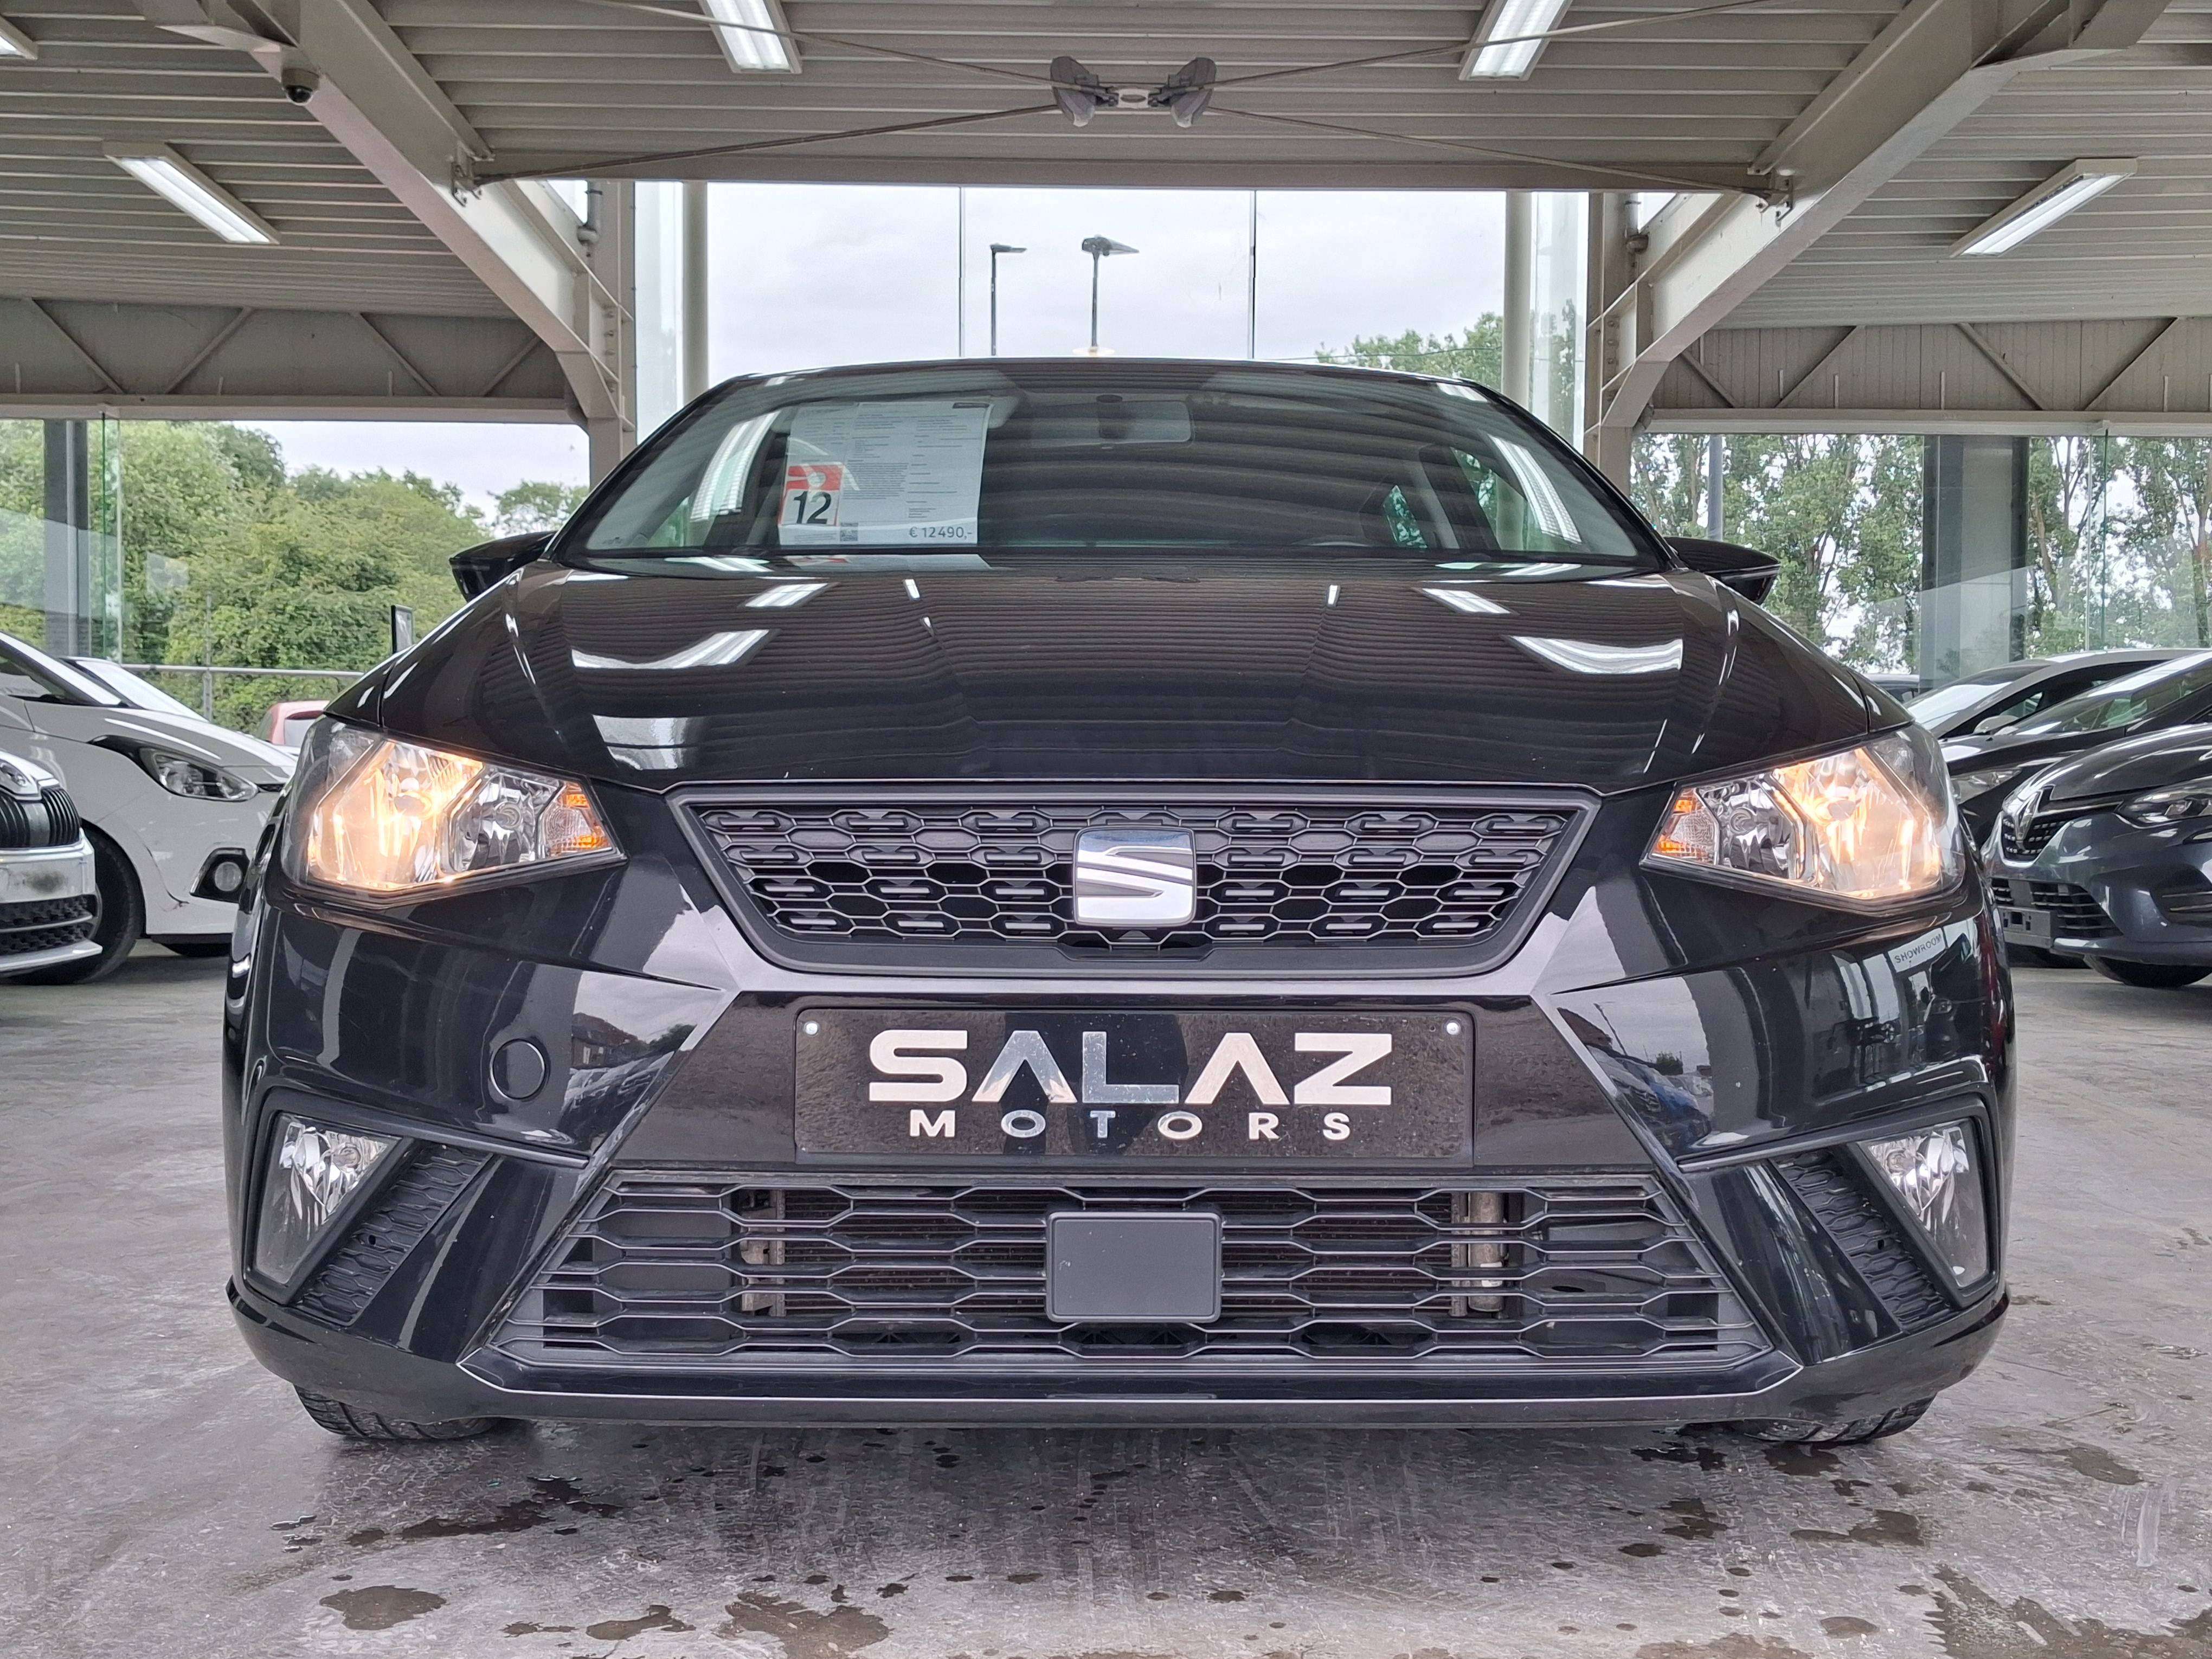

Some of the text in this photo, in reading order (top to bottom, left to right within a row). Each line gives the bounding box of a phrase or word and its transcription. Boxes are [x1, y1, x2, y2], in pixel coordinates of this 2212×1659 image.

[794, 491, 832, 524] 12
[1894, 934, 1942, 963] SHOWROOM
[869, 1030, 1392, 1104] SALAZ
[909, 1110, 1351, 1140] MOTORS
